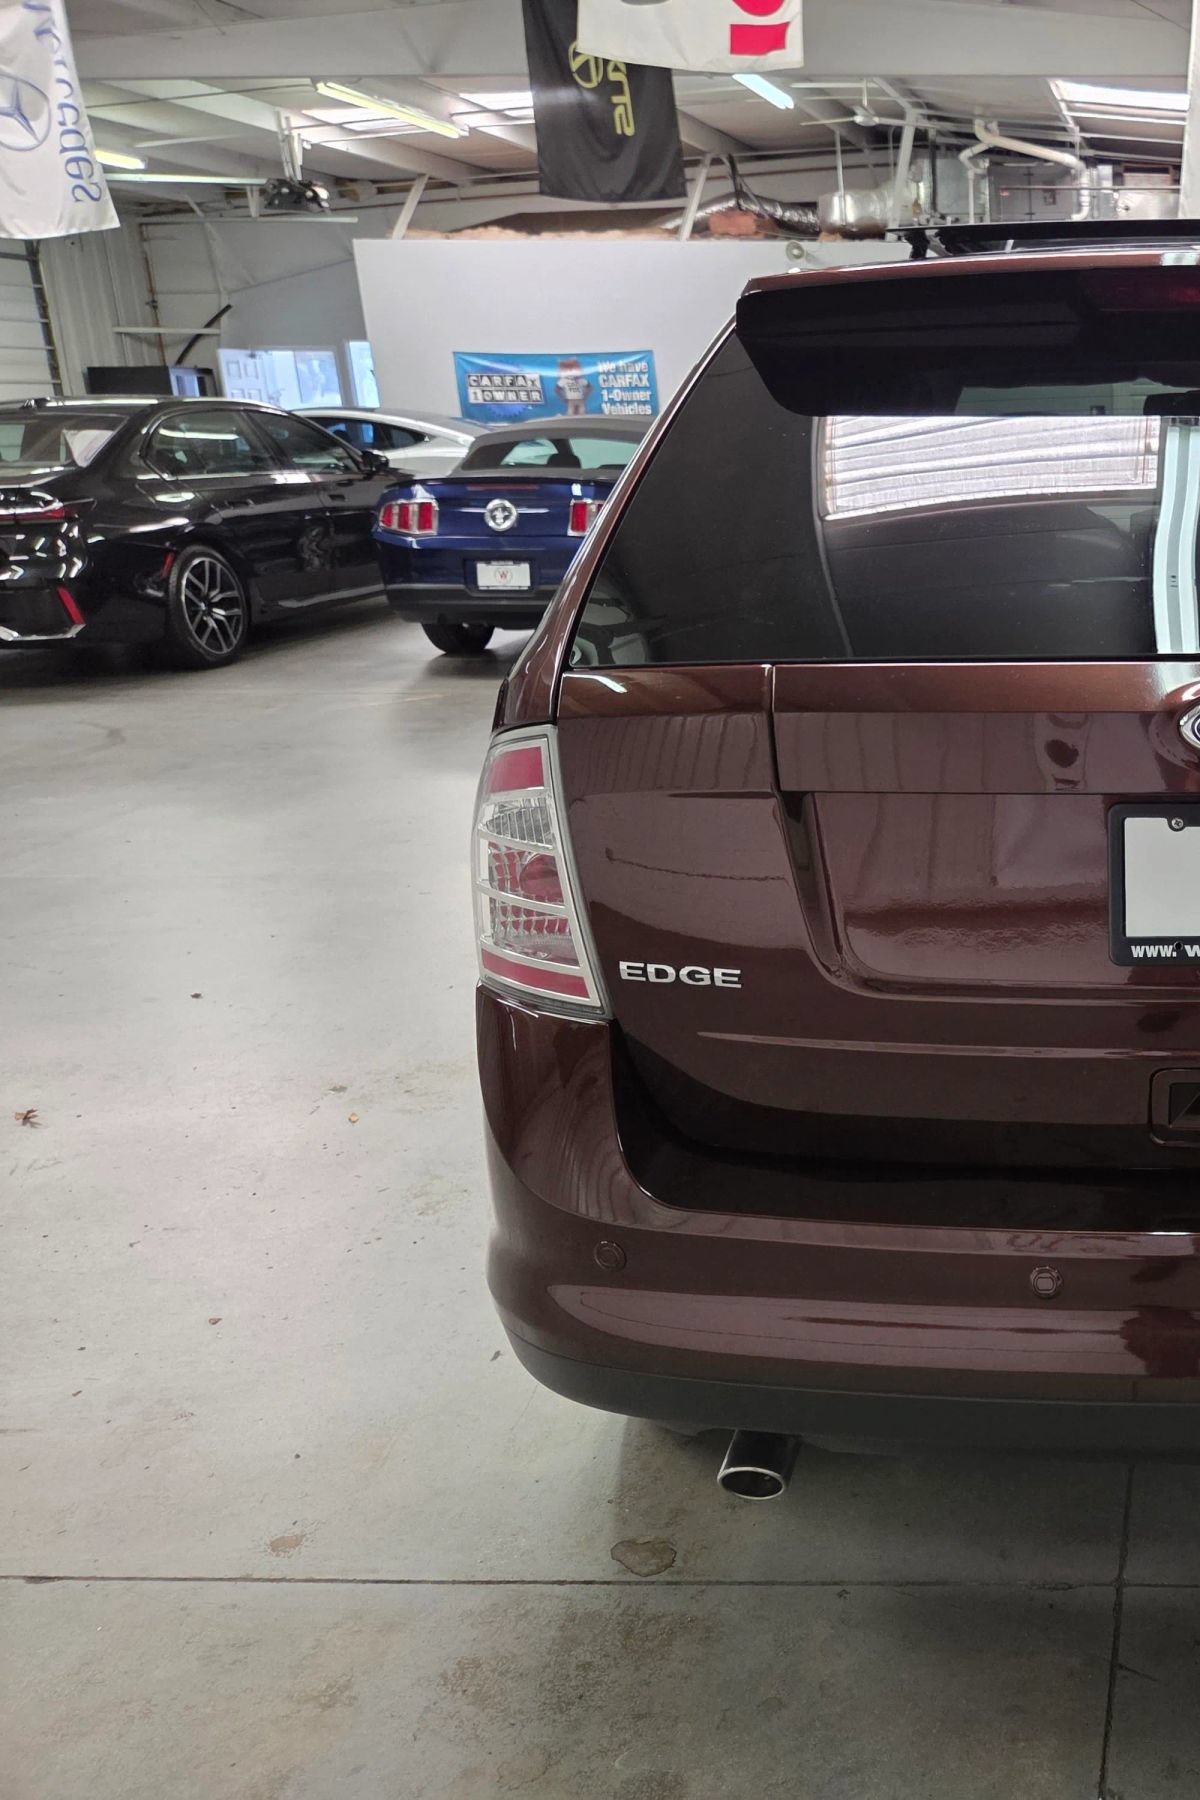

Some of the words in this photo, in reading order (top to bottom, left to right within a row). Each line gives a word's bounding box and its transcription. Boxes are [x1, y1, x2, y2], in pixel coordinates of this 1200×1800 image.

[469, 375, 541, 388] CARFAX
[599, 373, 650, 388] CARFAX
[601, 389, 651, 402] 1-Owner
[601, 402, 652, 415] Vehicles
[618, 960, 742, 988] EDGE
